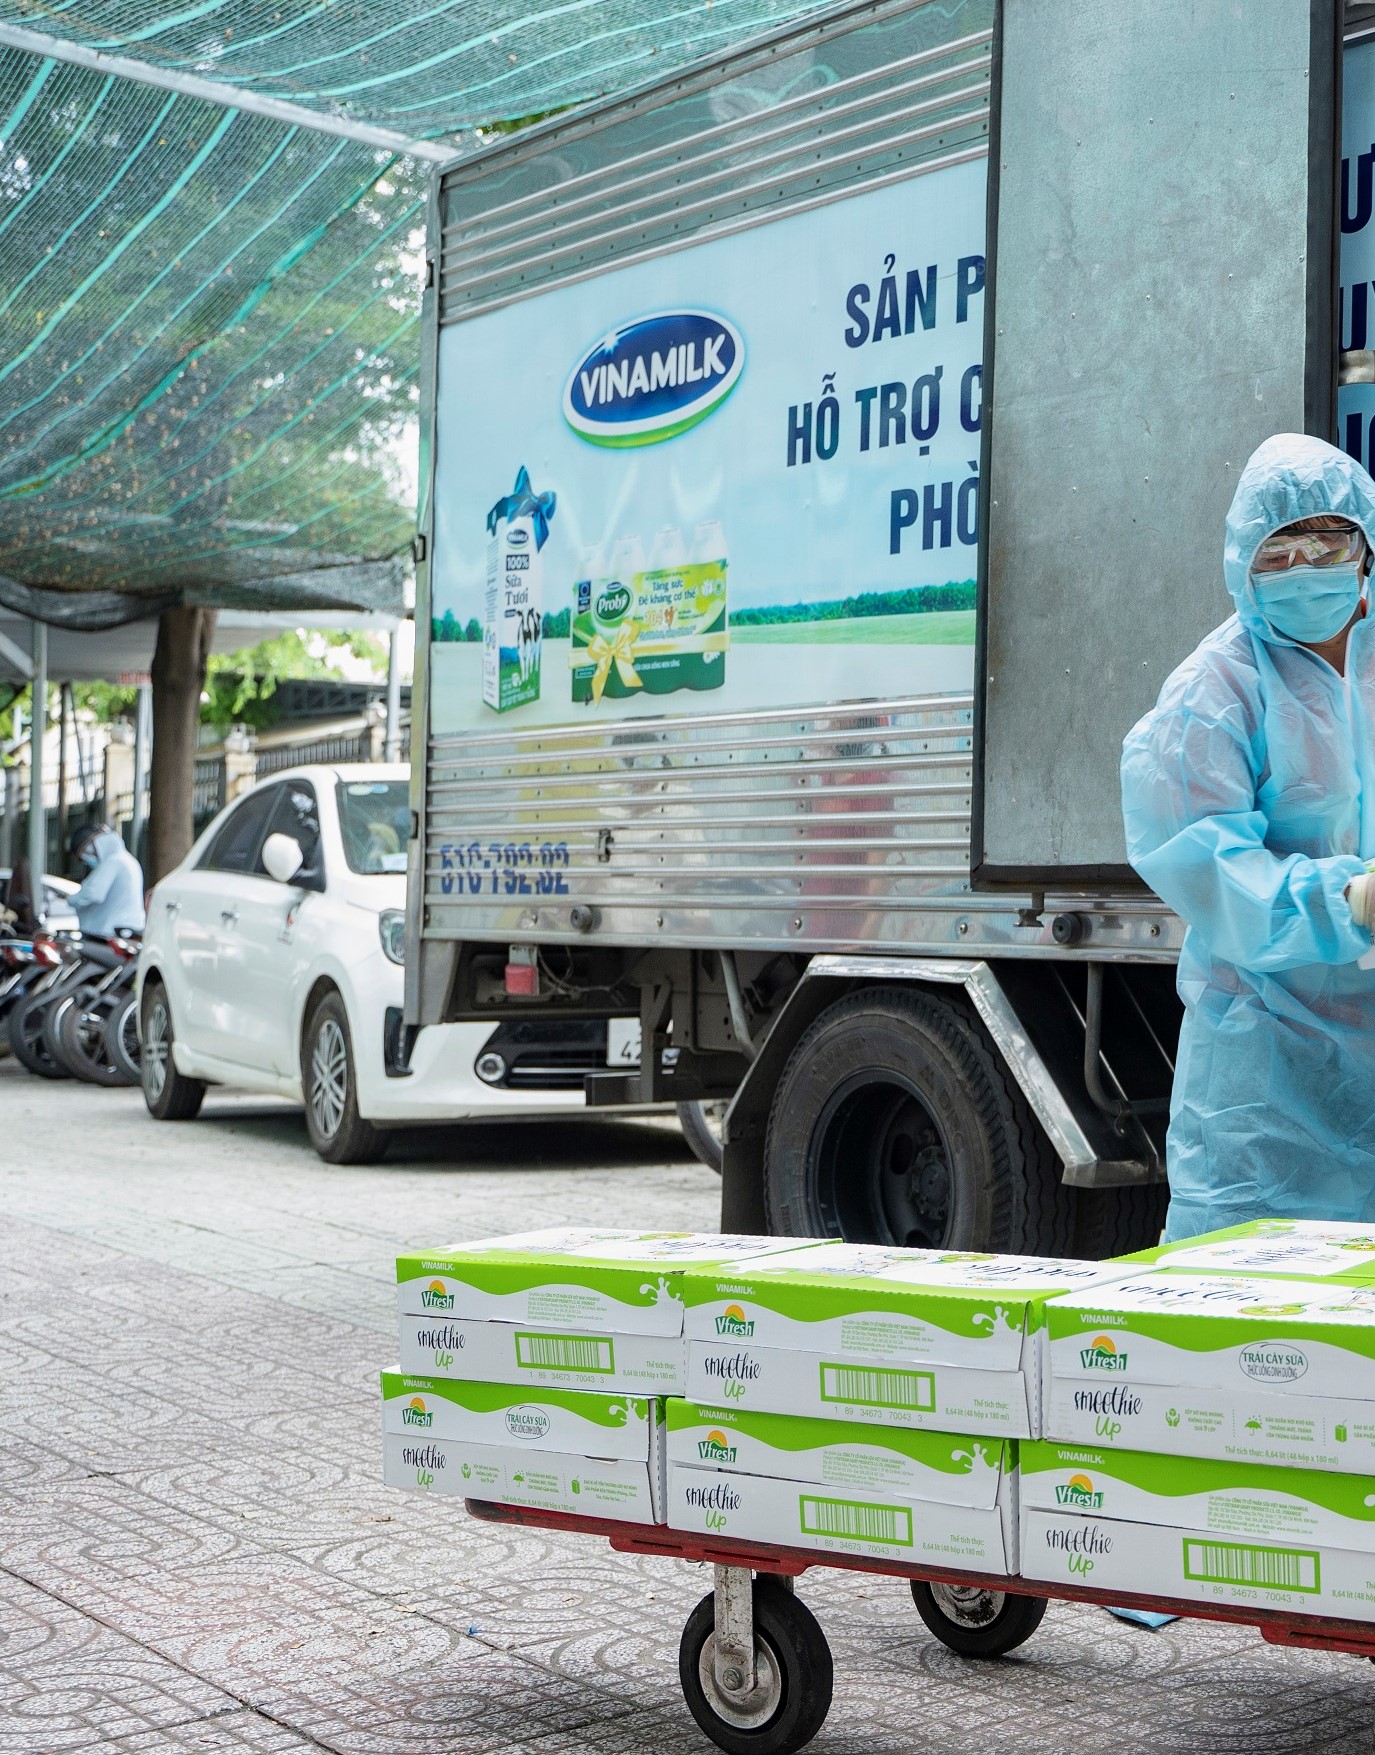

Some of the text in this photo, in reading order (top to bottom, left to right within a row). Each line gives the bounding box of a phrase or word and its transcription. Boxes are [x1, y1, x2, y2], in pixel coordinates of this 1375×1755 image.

[845, 254, 937, 348] SẢN
[580, 334, 726, 408] VINAMILK
[787, 372, 840, 468] HỖ
[855, 365, 944, 456] TRỢ
[506, 556, 529, 570] 100%
[504, 587, 528, 606] Tươi
[421, 1261, 453, 1271] VINAMILK
[421, 1290, 454, 1309] Vfresh
[716, 1284, 754, 1295] VINAMILK
[715, 1315, 755, 1337] Vfresh
[1080, 1314, 1125, 1326] VINAMILK
[417, 1325, 466, 1350] smoothie
[434, 1349, 454, 1371] Up
[704, 1352, 761, 1380] smoothie
[1080, 1348, 1127, 1372] Vfresh
[1243, 1351, 1304, 1367] TRÁI CÂY SỮA
[402, 1379, 433, 1389] VINAMILK
[538, 1372, 547, 1380] 89
[551, 1373, 571, 1382] 34673
[575, 1375, 595, 1384] 70043
[723, 1379, 746, 1402] Up
[1073, 1385, 1143, 1416] smoothie
[402, 1408, 433, 1427] Vfresh
[698, 1409, 736, 1421] VINAMILK
[835, 1405, 923, 1422] 1 89 34673 70043 3
[1095, 1414, 1122, 1441] Up
[402, 1445, 447, 1469] smoothie
[698, 1441, 737, 1463] Vfresh
[1057, 1450, 1102, 1464] VINAMILK
[417, 1468, 434, 1490] Up
[685, 1483, 742, 1510] smoothie
[1055, 1486, 1104, 1509] Vfresh
[705, 1509, 727, 1532] Up
[814, 1537, 901, 1556] 1 89 34673 70043 3
[1047, 1525, 1113, 1555] smoothie
[1069, 1551, 1094, 1578] Up
[1200, 1585, 1305, 1604] 1 89 34673 70043 3
[1331, 1589, 1345, 1600] 8,64
[1354, 1591, 1365, 1602] (48
